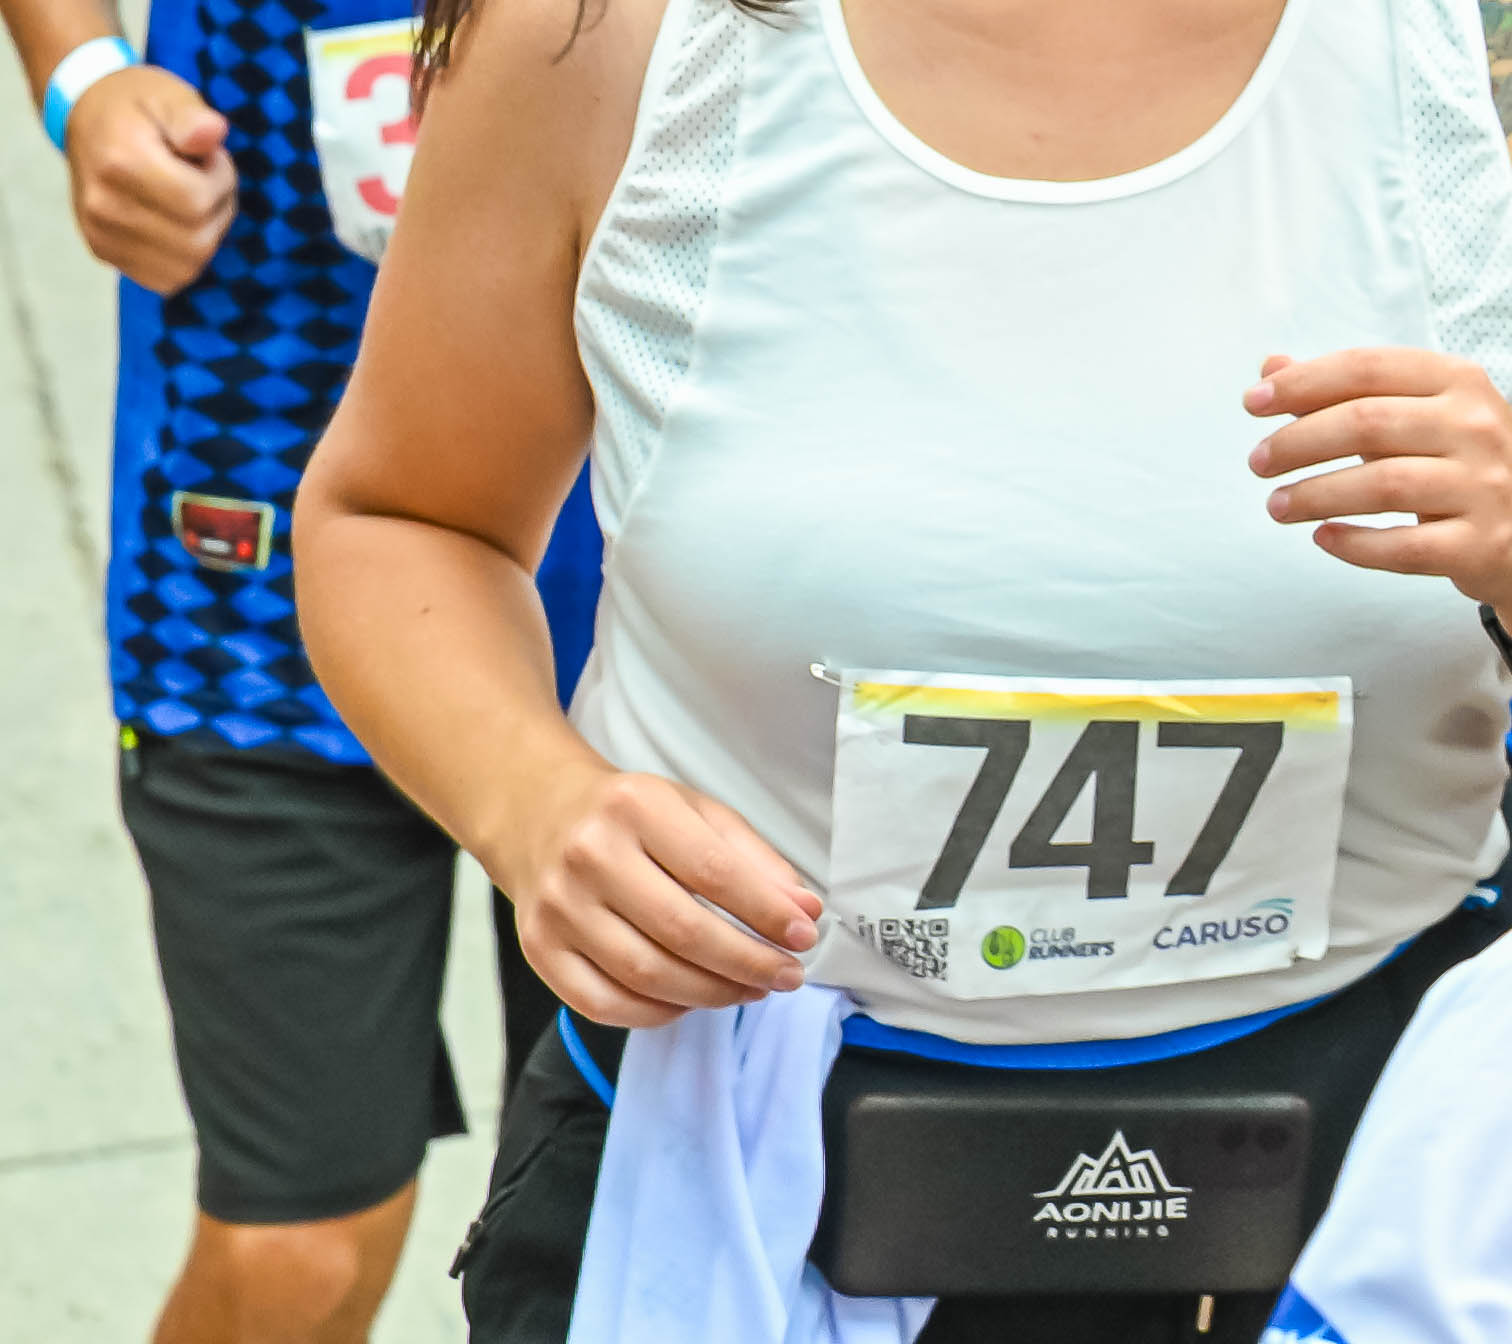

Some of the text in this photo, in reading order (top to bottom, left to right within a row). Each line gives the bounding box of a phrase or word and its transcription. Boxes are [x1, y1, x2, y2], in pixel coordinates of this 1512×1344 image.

[902, 713, 1285, 911] 747
[1152, 913, 1290, 951] CARUSO
[1031, 1197, 1189, 1223] AONIJIE
[1046, 1225, 1170, 1239] RUNNING
